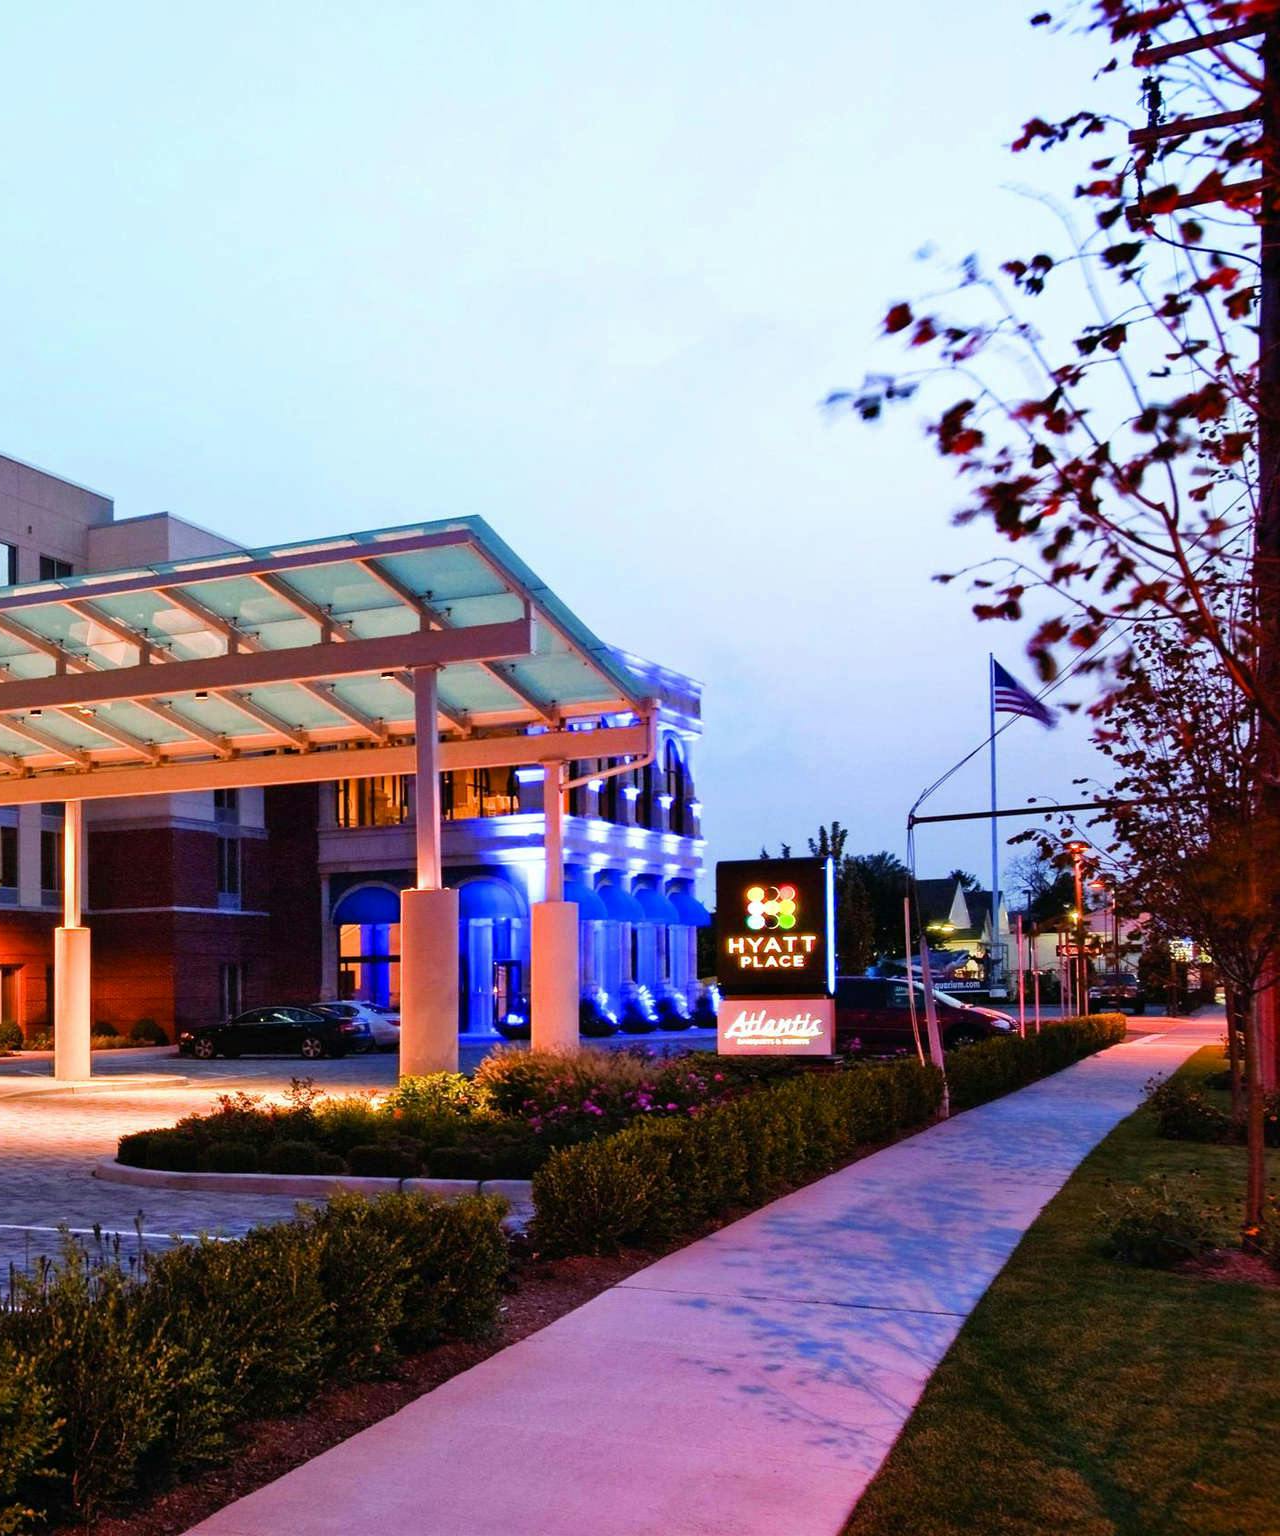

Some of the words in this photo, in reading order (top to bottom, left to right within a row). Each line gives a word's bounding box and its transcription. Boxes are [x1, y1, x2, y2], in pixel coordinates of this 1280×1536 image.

[728, 935, 817, 954] HYATT
[740, 955, 805, 969] PLACE
[934, 980, 981, 990] quarium.com
[724, 1009, 823, 1039] Atlantis
